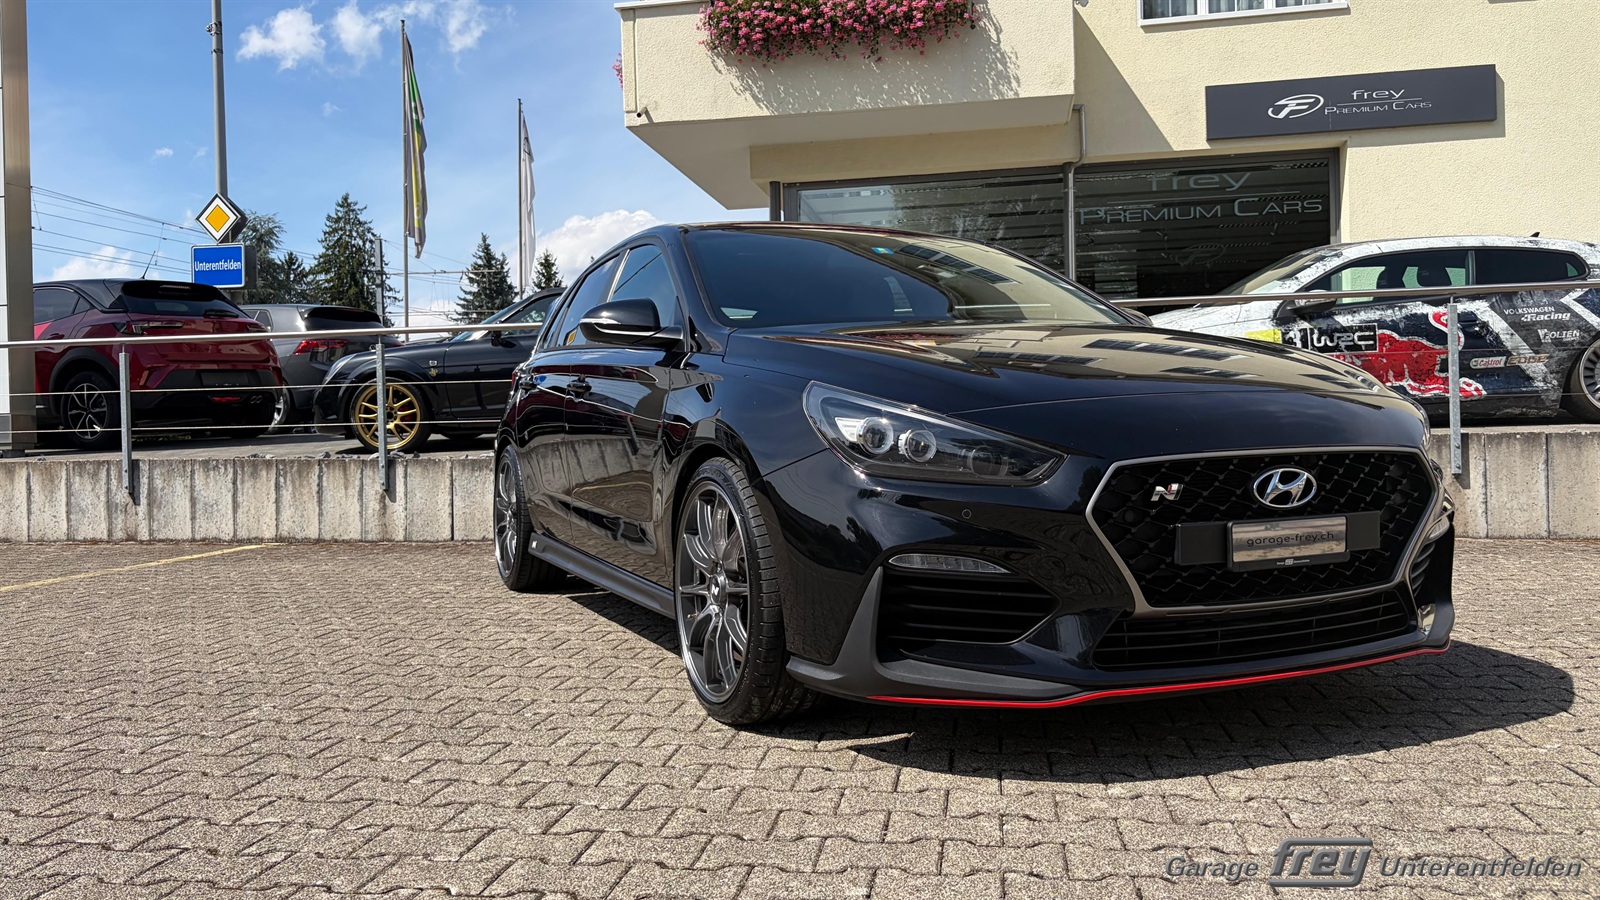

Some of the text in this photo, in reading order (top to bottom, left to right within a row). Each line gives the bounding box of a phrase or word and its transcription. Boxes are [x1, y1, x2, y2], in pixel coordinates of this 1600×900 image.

[1351, 89, 1405, 100] frey
[1149, 172, 1251, 192] frey
[195, 259, 242, 271] Unterentfelden
[1504, 306, 1555, 315] VOLKSWAGEN
[1527, 312, 1571, 322] Racing
[1479, 355, 1548, 367] Castrol EDGE
[1246, 531, 1335, 547] garage-frey.ch
